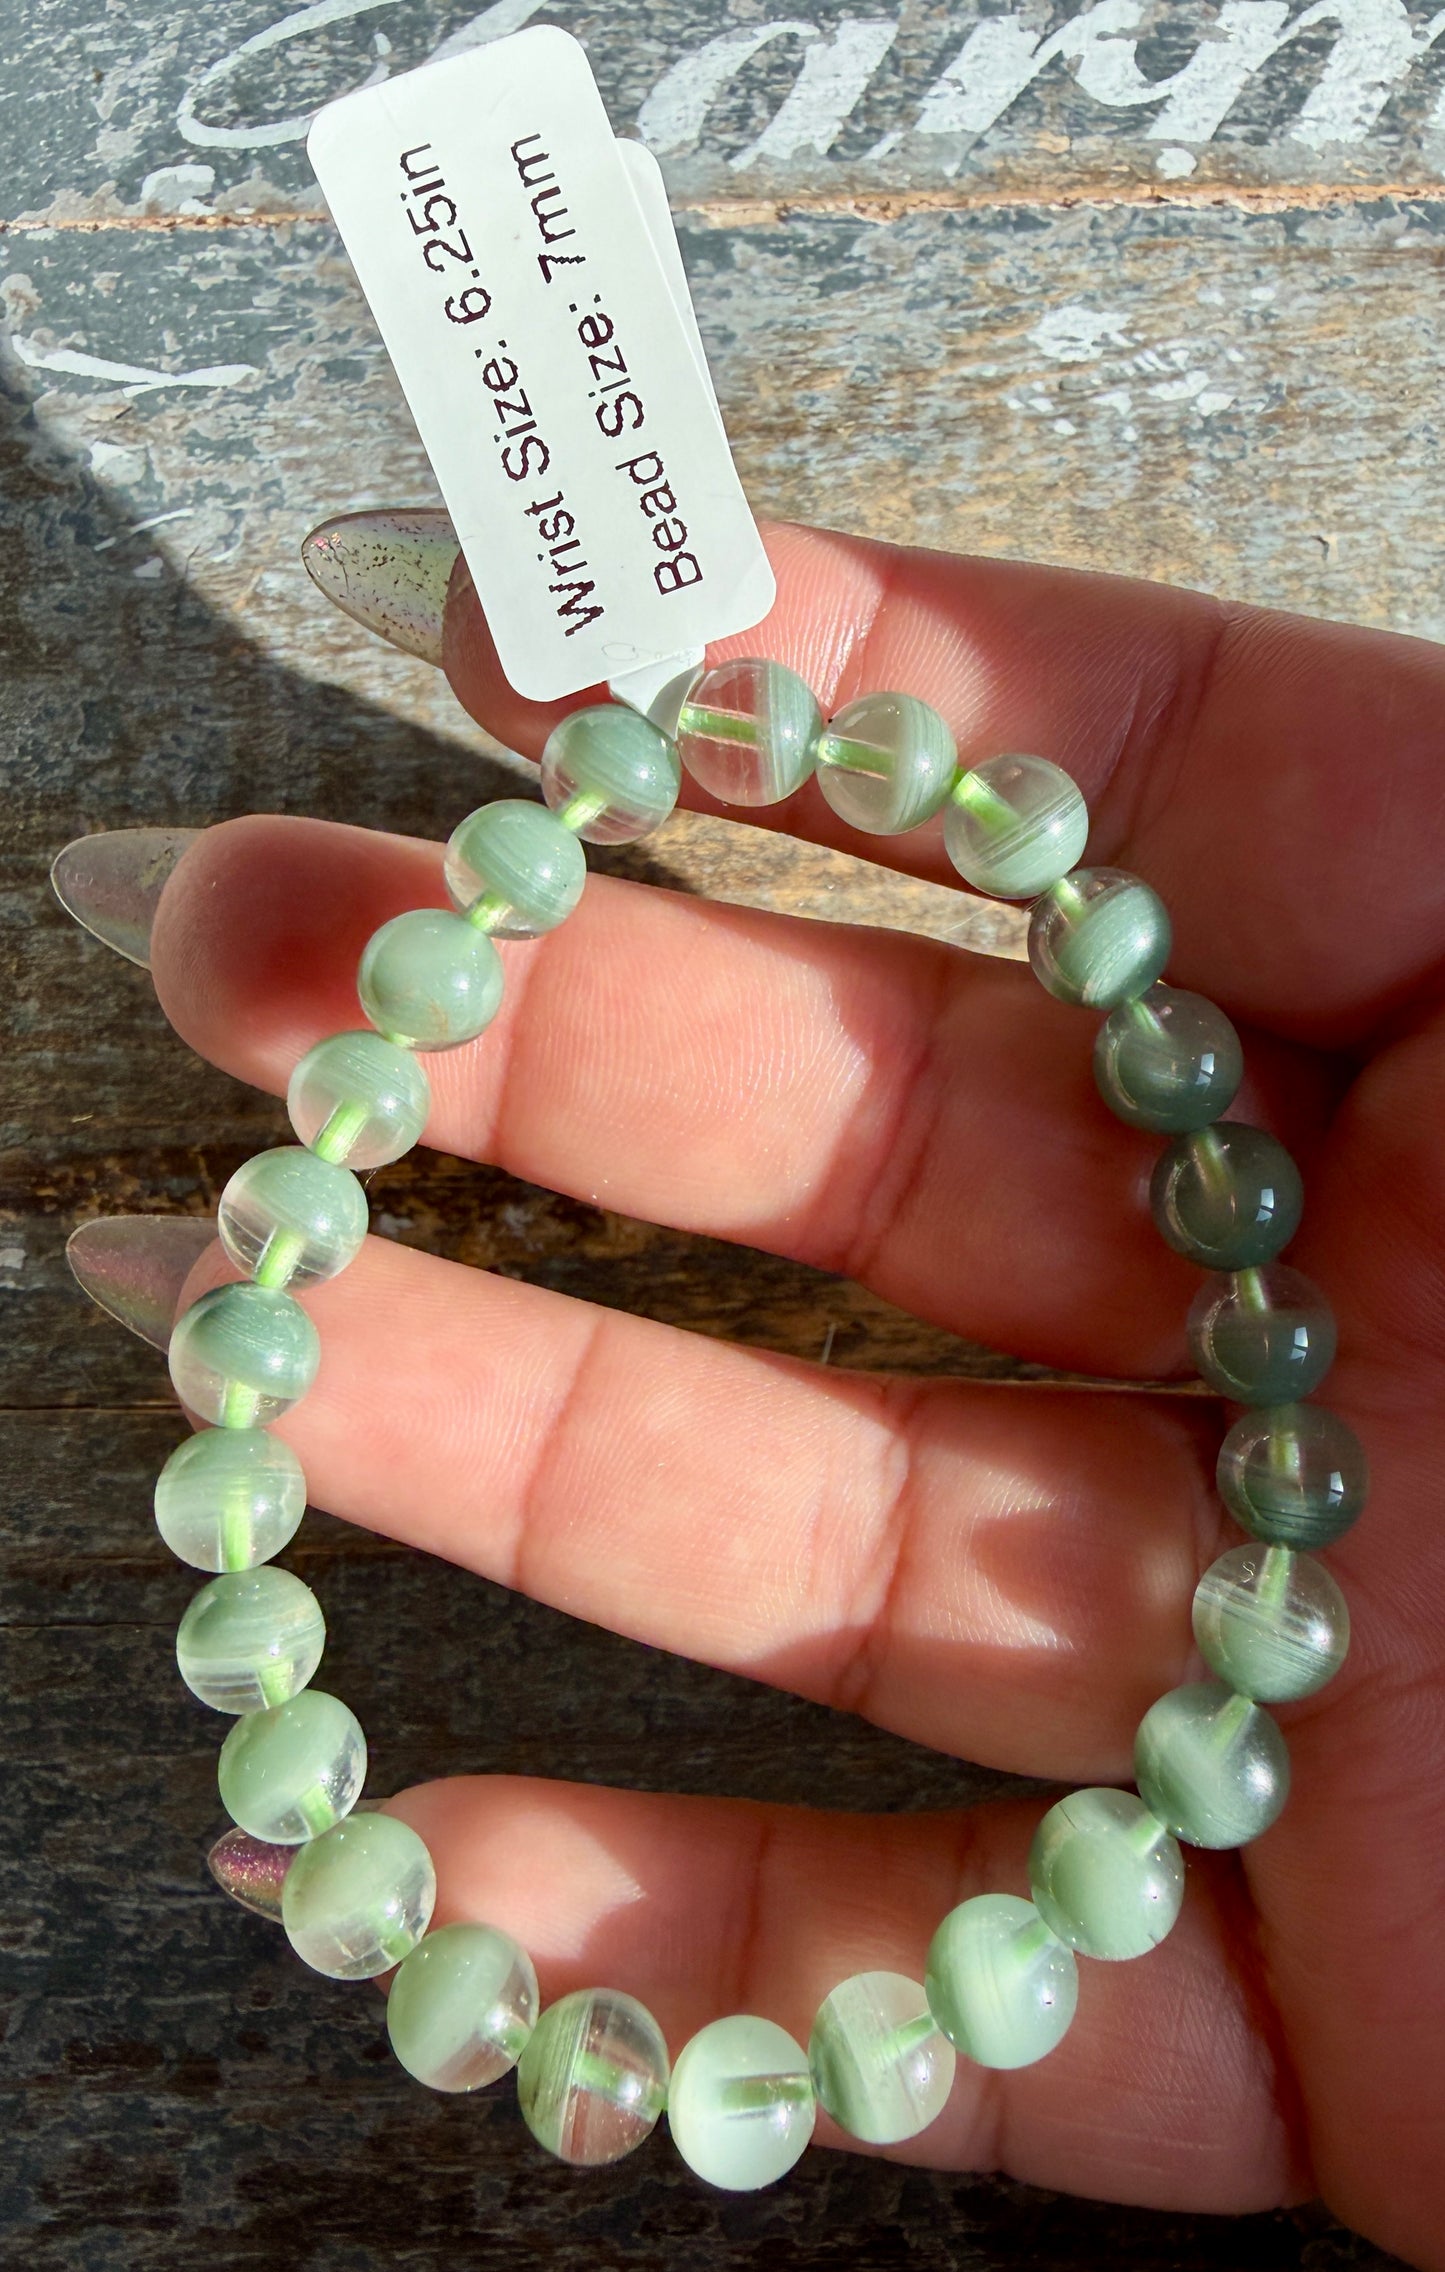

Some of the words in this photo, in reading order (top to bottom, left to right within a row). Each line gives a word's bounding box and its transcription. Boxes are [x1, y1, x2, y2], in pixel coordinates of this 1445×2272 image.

[399, 143, 492, 325] 6.25in
[510, 133, 587, 284] 7mm
[474, 339, 551, 482] Size:
[568, 293, 645, 438] Size:
[523, 490, 605, 637] Wrist
[614, 450, 704, 596] Bead
